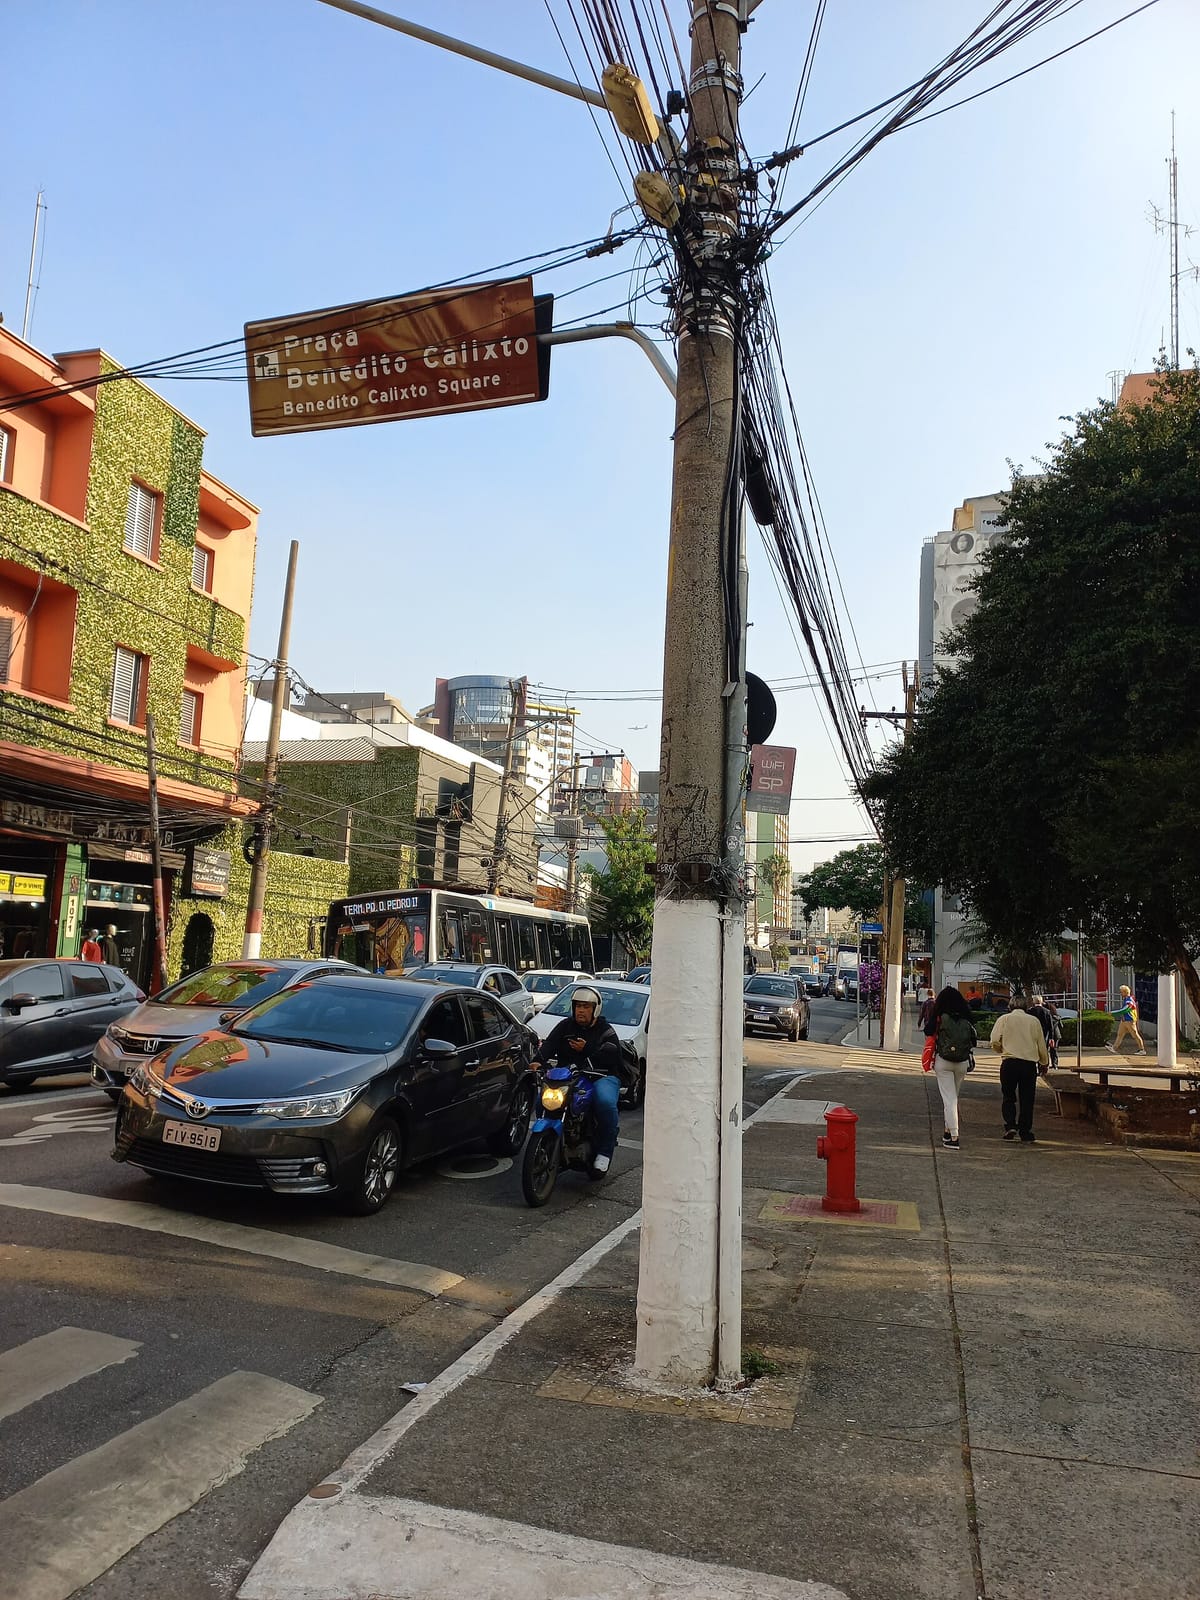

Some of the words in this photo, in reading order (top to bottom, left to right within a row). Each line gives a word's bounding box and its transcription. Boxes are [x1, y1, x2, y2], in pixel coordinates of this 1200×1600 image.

[283, 329, 360, 358] Praça
[286, 352, 408, 390] Benedito
[422, 334, 530, 369] Calixto
[283, 392, 360, 416] Benedito
[367, 384, 429, 405] Calixto
[437, 372, 502, 396] Square
[758, 776, 784, 791] SP
[387, 898, 411, 911] PEDRO
